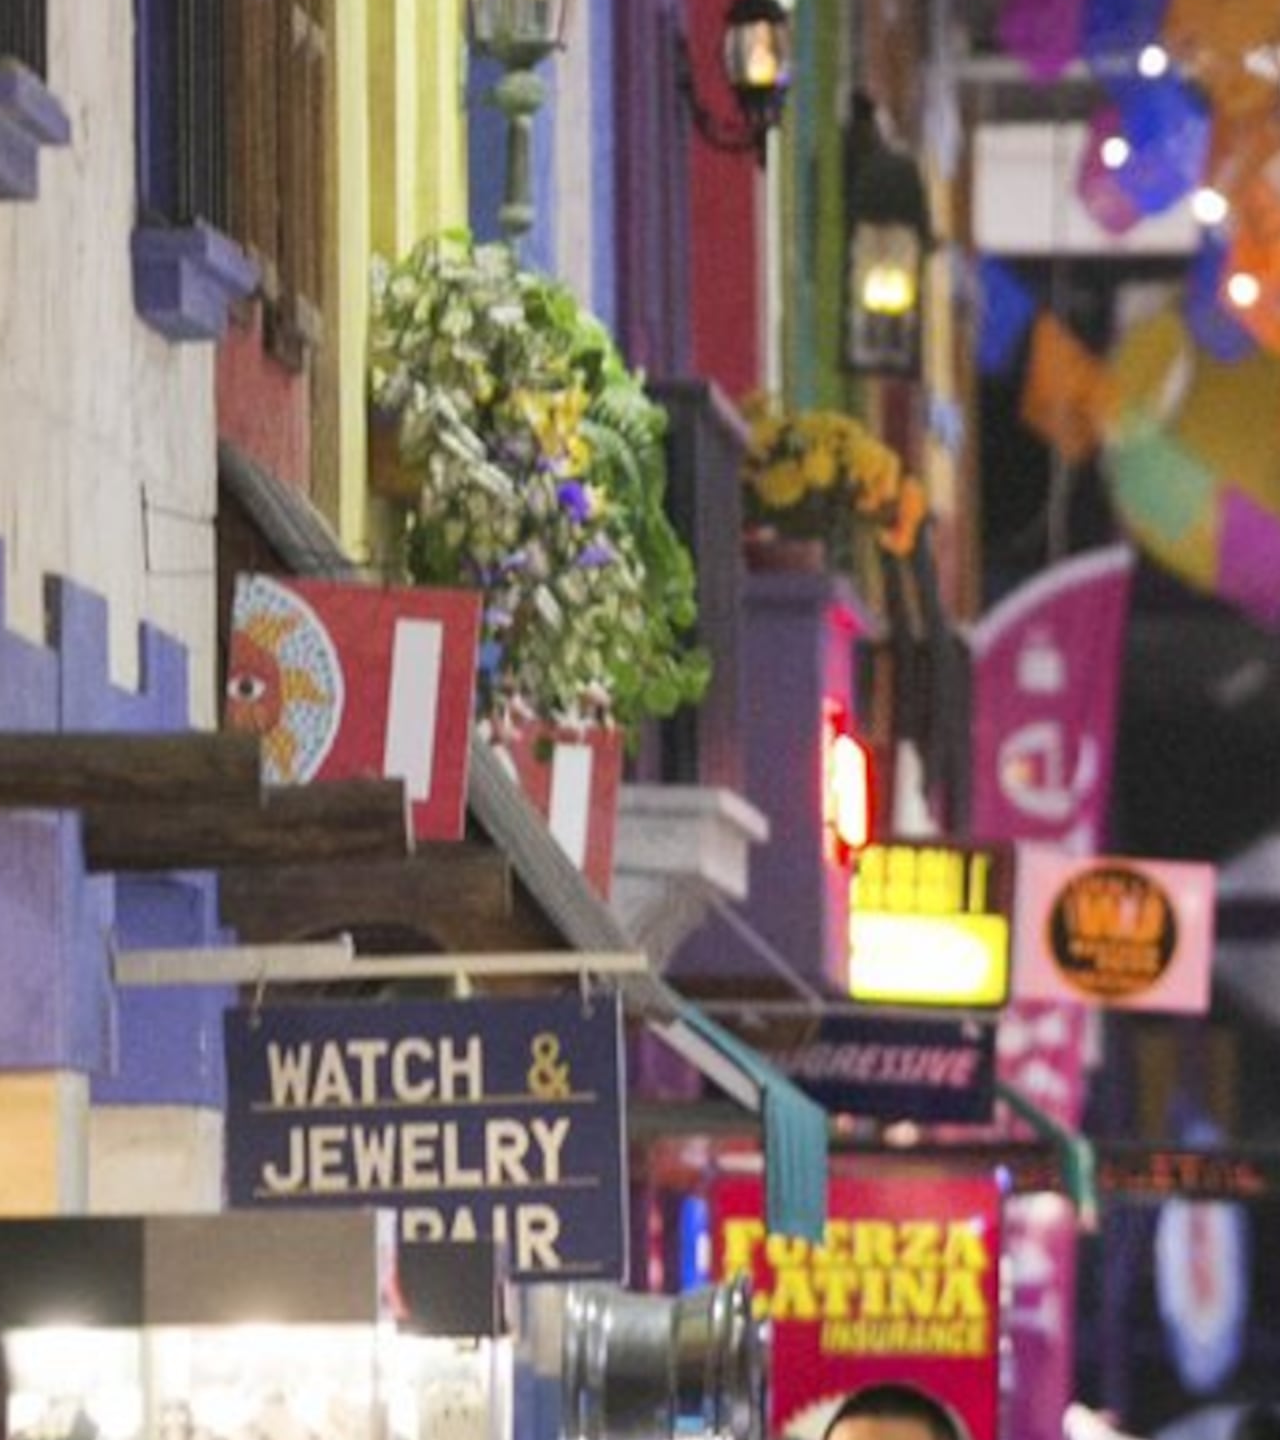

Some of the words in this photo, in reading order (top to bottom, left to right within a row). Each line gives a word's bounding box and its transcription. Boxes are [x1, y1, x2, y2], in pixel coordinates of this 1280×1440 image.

[266, 1034, 484, 1108] WATCH
[528, 1032, 571, 1098] &
[263, 1116, 571, 1193] JEWELRY
[402, 1203, 562, 1273] PAIR
[750, 1268, 985, 1319] ATINA
